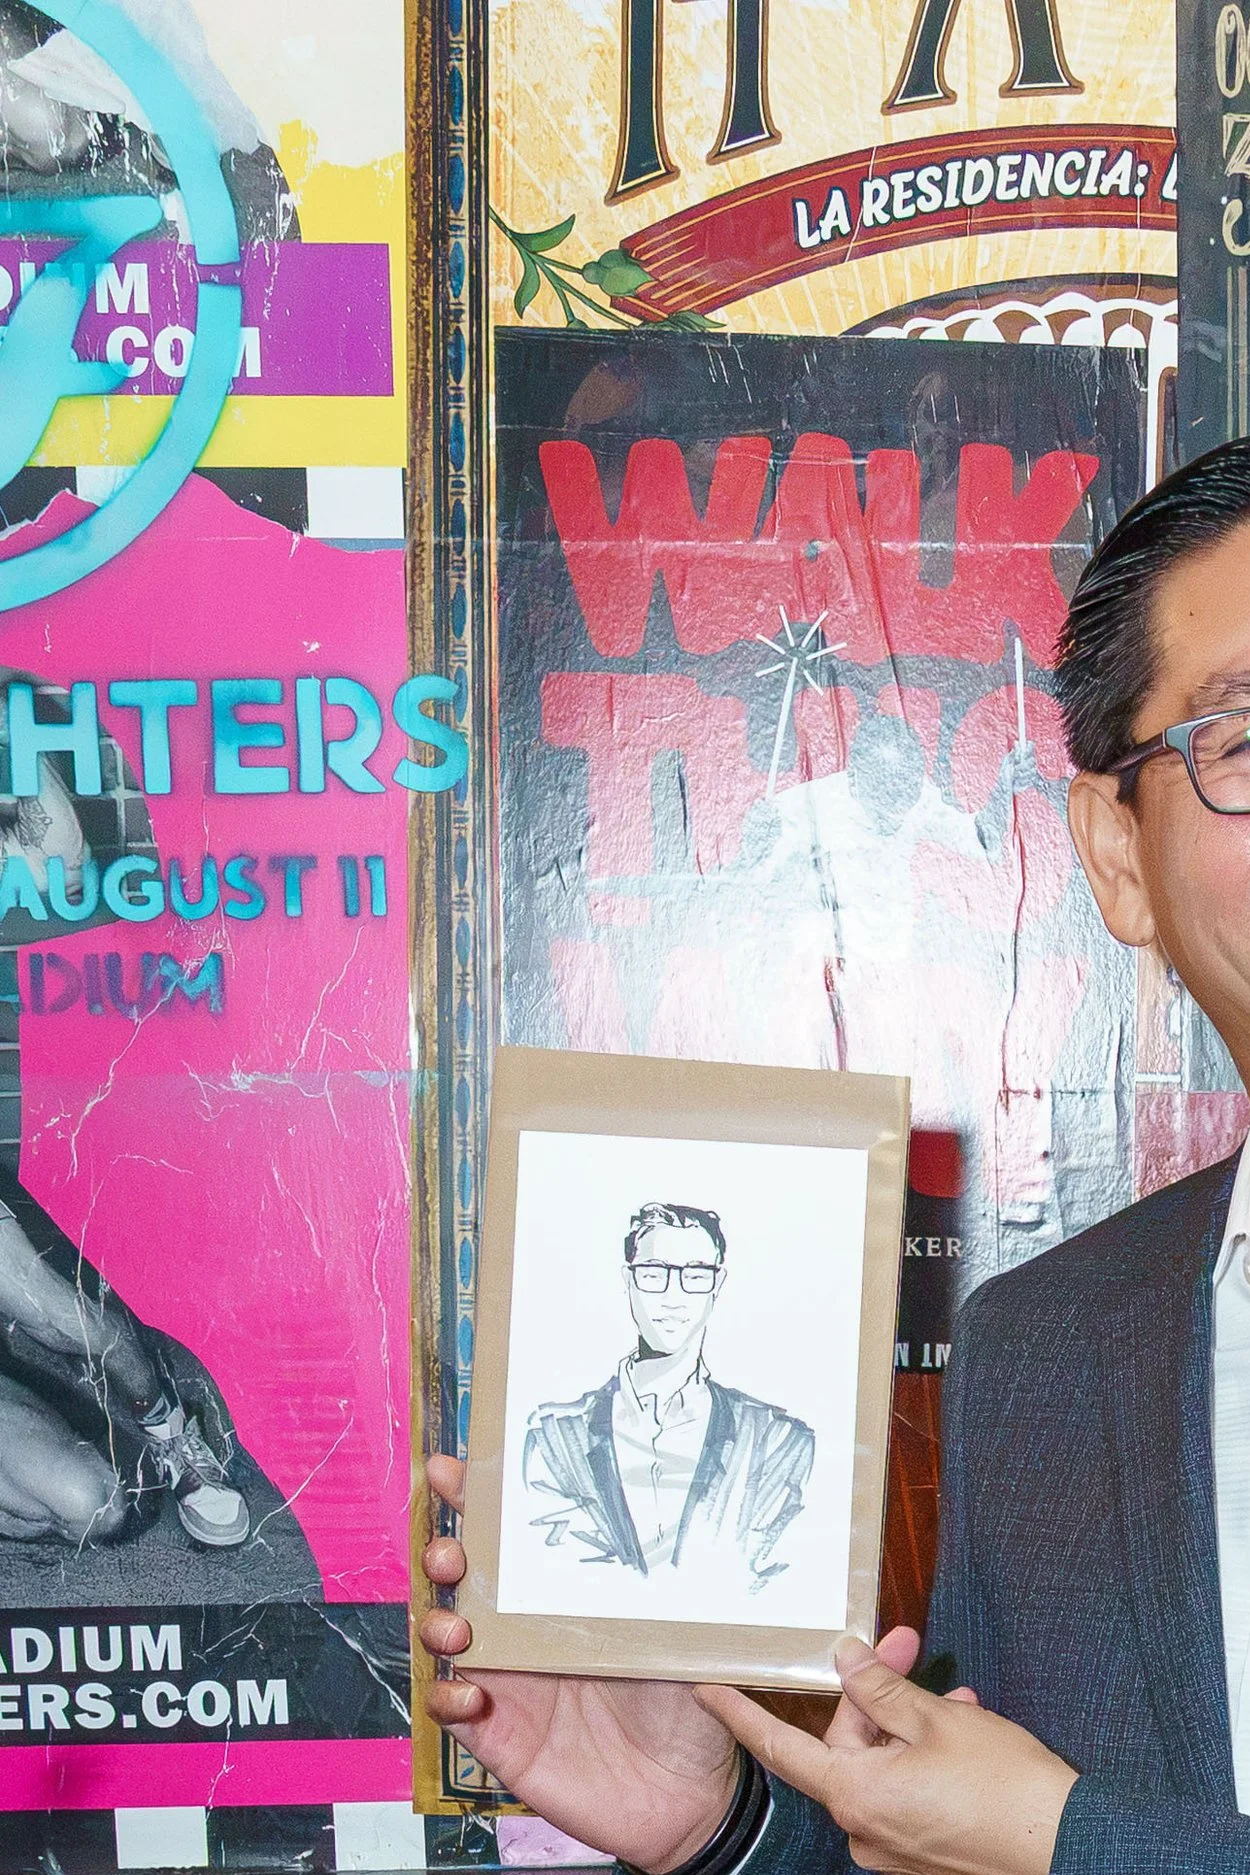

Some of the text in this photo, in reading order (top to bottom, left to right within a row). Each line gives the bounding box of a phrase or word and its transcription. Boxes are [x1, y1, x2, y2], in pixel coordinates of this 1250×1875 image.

[795, 188, 851, 249] LA
[862, 150, 1149, 228] RESIDENCIA:
[538, 432, 1100, 669] WALK
[8, 674, 469, 796] HTERS
[0, 854, 318, 923] AUGUST
[0, 951, 227, 1018] DIUM
[0, 1624, 183, 1674] DIUM
[0, 1678, 290, 1730] ERS.COM
